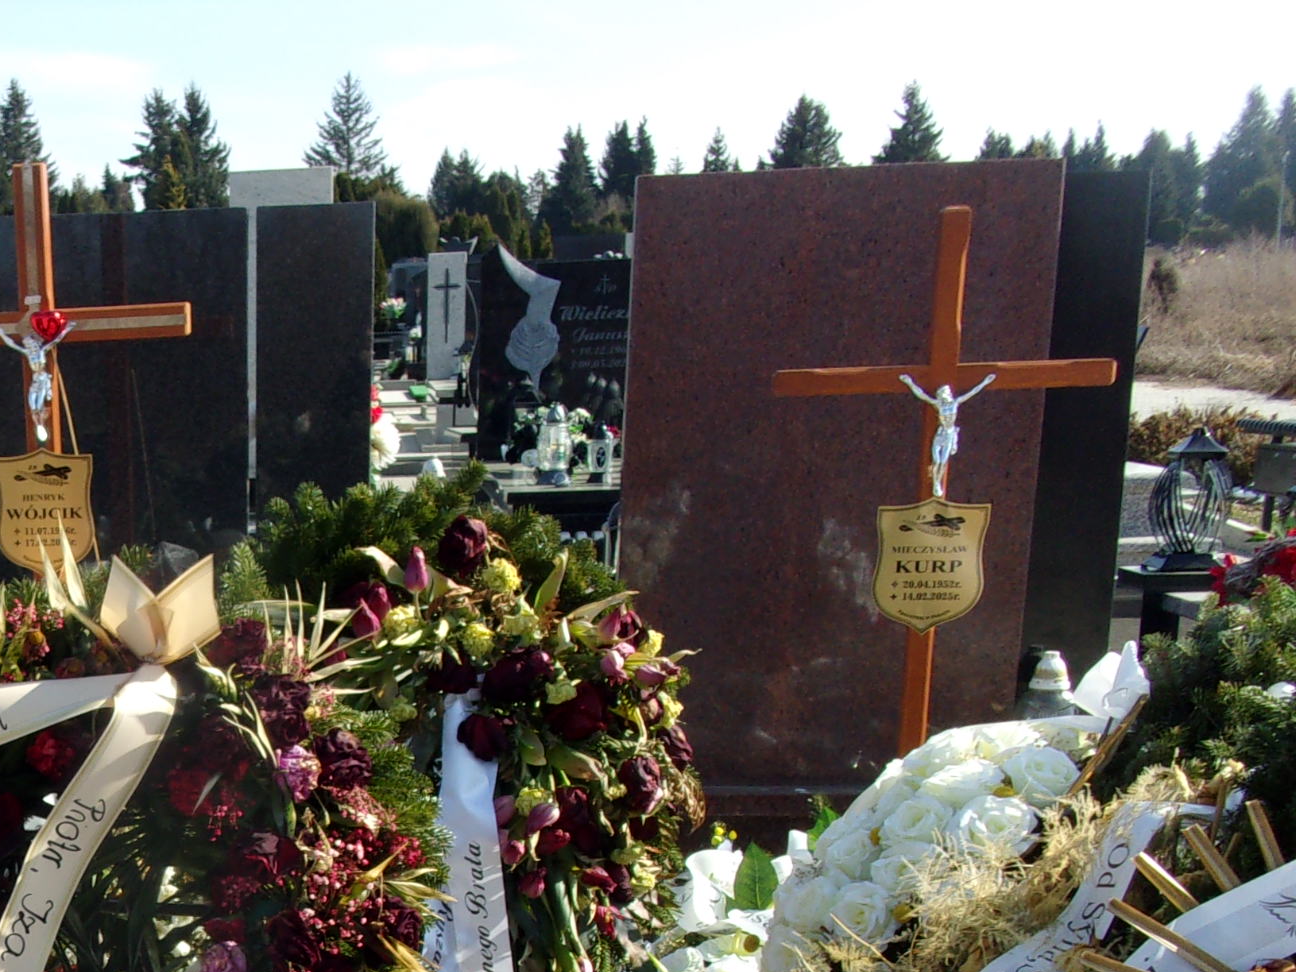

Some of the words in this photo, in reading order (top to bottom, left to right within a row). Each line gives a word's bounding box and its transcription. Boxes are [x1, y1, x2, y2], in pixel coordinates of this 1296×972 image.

[23, 493, 65, 501] HENRYK
[6, 504, 82, 520] WÓJCIK
[891, 545, 968, 553] MIECZYSŁAW
[895, 560, 963, 574] KURP
[1096, 841, 1130, 888] Od
[464, 841, 490, 919] Brata
